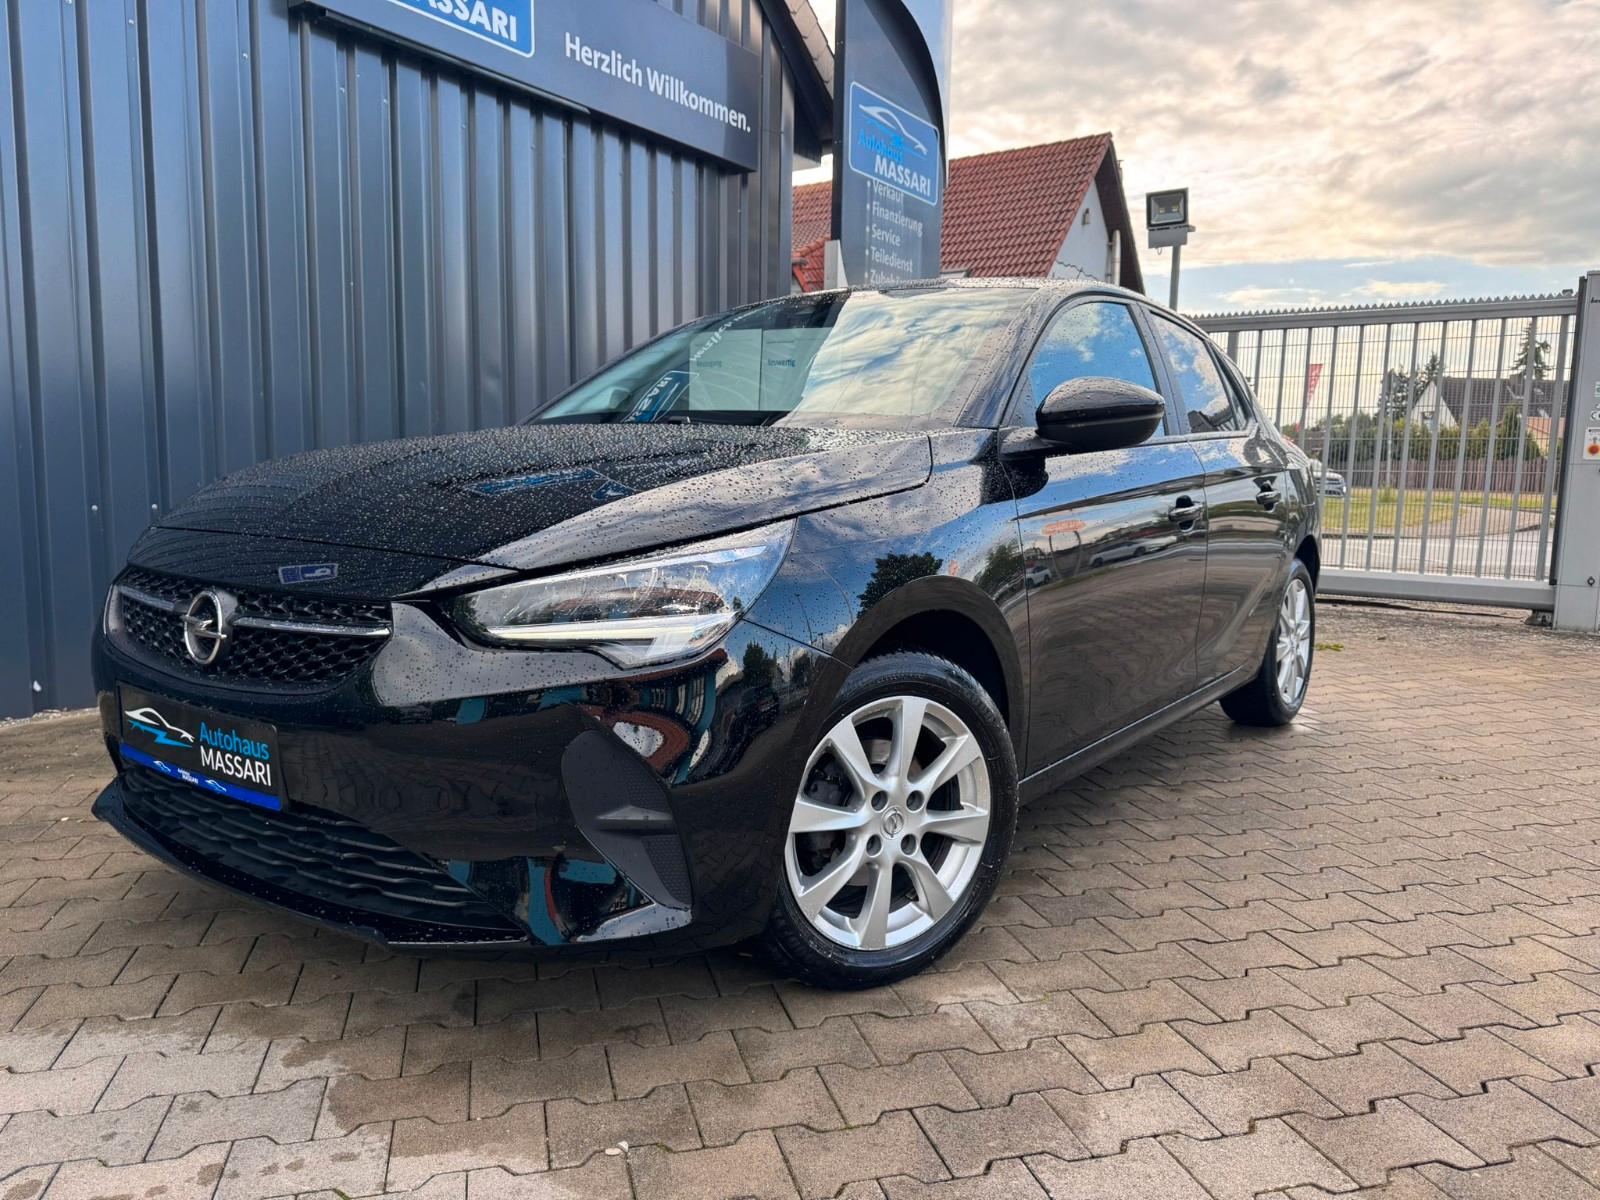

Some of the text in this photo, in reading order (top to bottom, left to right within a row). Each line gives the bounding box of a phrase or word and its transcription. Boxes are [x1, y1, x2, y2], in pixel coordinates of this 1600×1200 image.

[565, 31, 752, 133] Herzlich Willkommen.
[874, 153, 931, 197] MASSARI
[871, 223, 901, 247] Service
[872, 201, 923, 238] Finanzierung
[870, 245, 913, 273] Teiledienst
[199, 721, 270, 761] Autohaus
[199, 744, 272, 787] MASSARI
